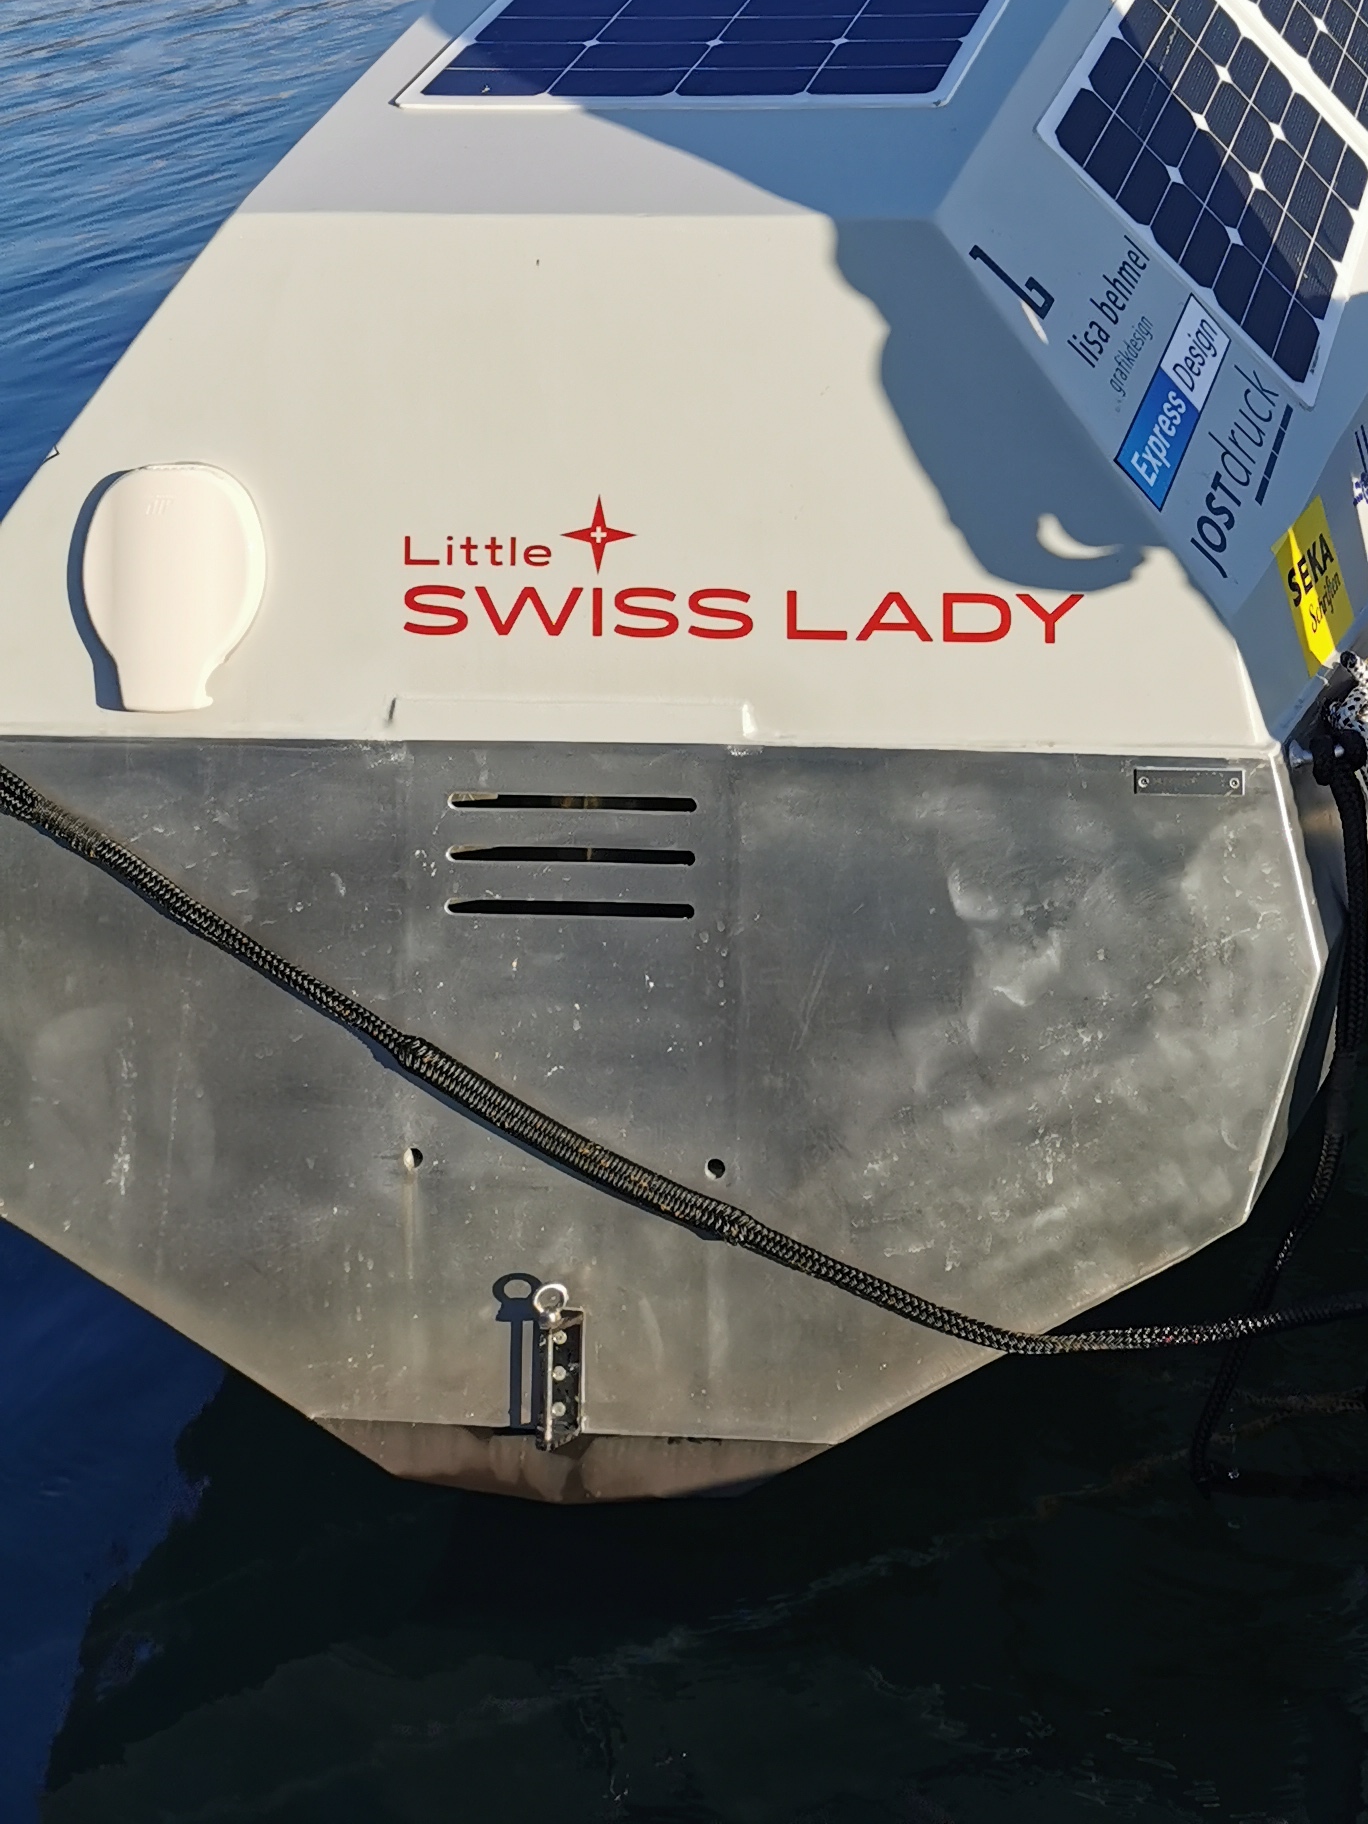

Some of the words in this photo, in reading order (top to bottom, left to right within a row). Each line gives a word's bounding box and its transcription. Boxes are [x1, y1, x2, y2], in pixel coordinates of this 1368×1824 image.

[1066, 319, 1111, 369] lisa
[1089, 234, 1151, 326] behmel
[1109, 315, 1154, 398] grafikdesign
[1130, 390, 1187, 487] Express
[1172, 318, 1218, 393] Design
[403, 535, 553, 567] Little
[1287, 532, 1335, 608] SEKA
[402, 584, 755, 640] SWISS
[786, 589, 1085, 644] LADY
